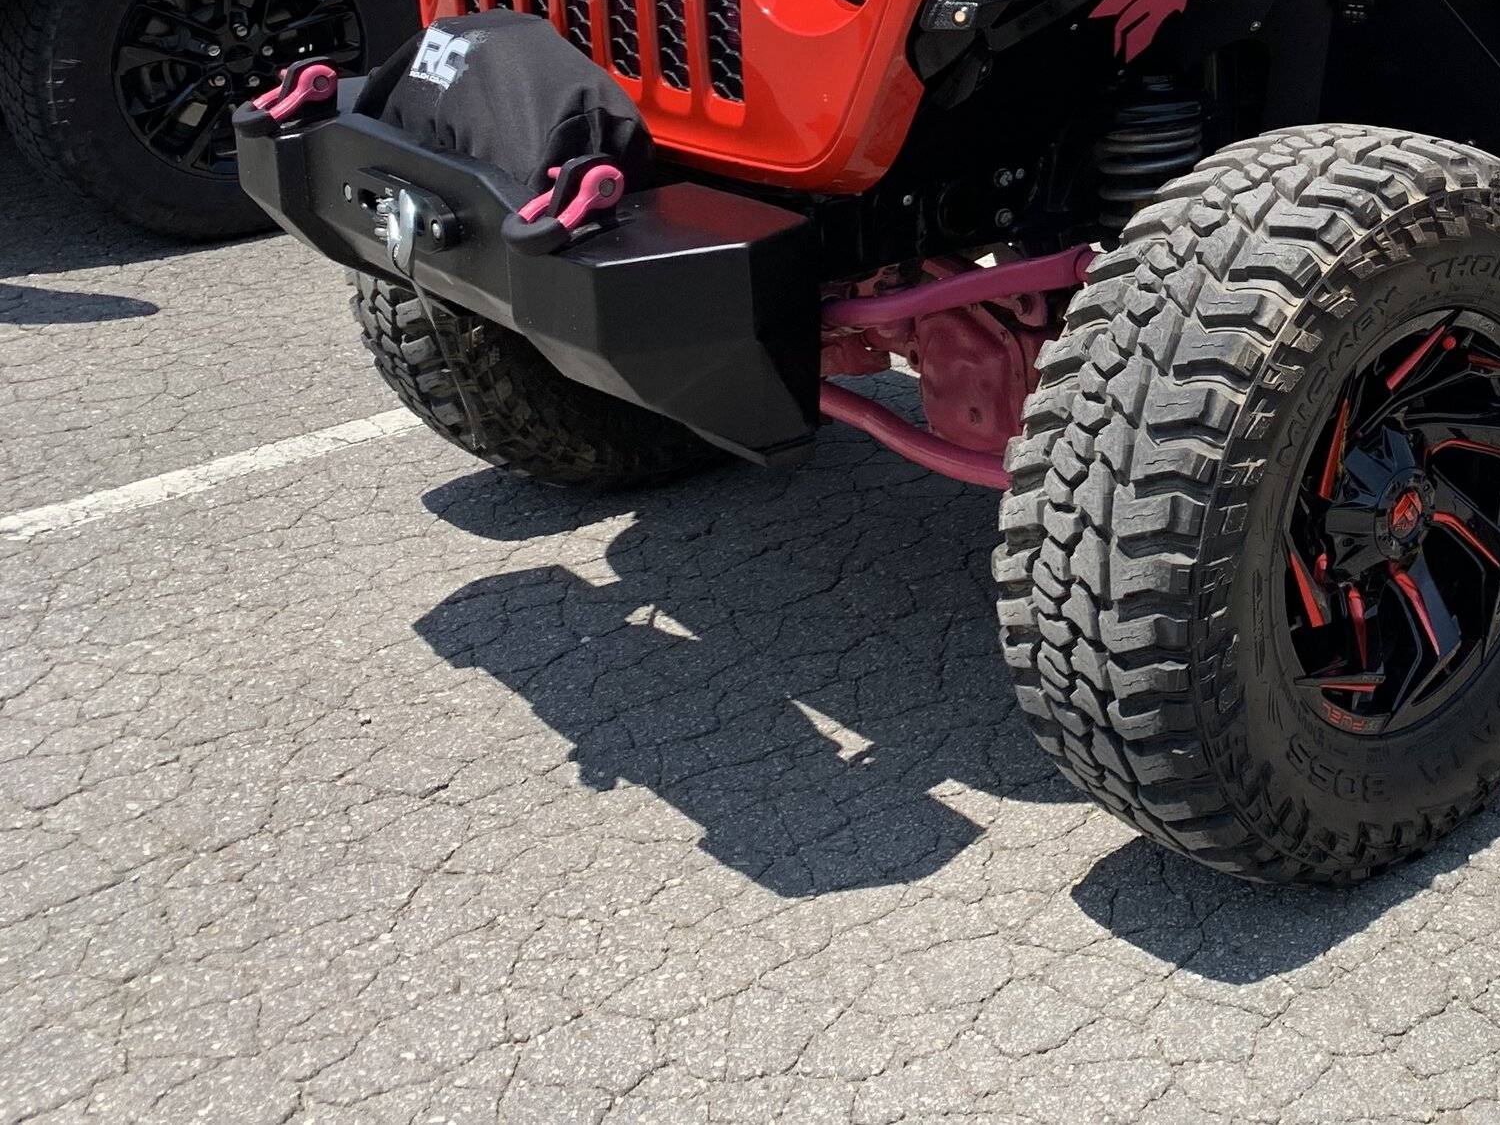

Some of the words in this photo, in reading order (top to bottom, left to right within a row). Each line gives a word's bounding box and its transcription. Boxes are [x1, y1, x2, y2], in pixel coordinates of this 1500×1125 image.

[411, 26, 471, 83] RC
[1275, 285, 1403, 470] MICKEY
[1321, 701, 1365, 733] FUEL
[1286, 733, 1394, 804] BOSS
